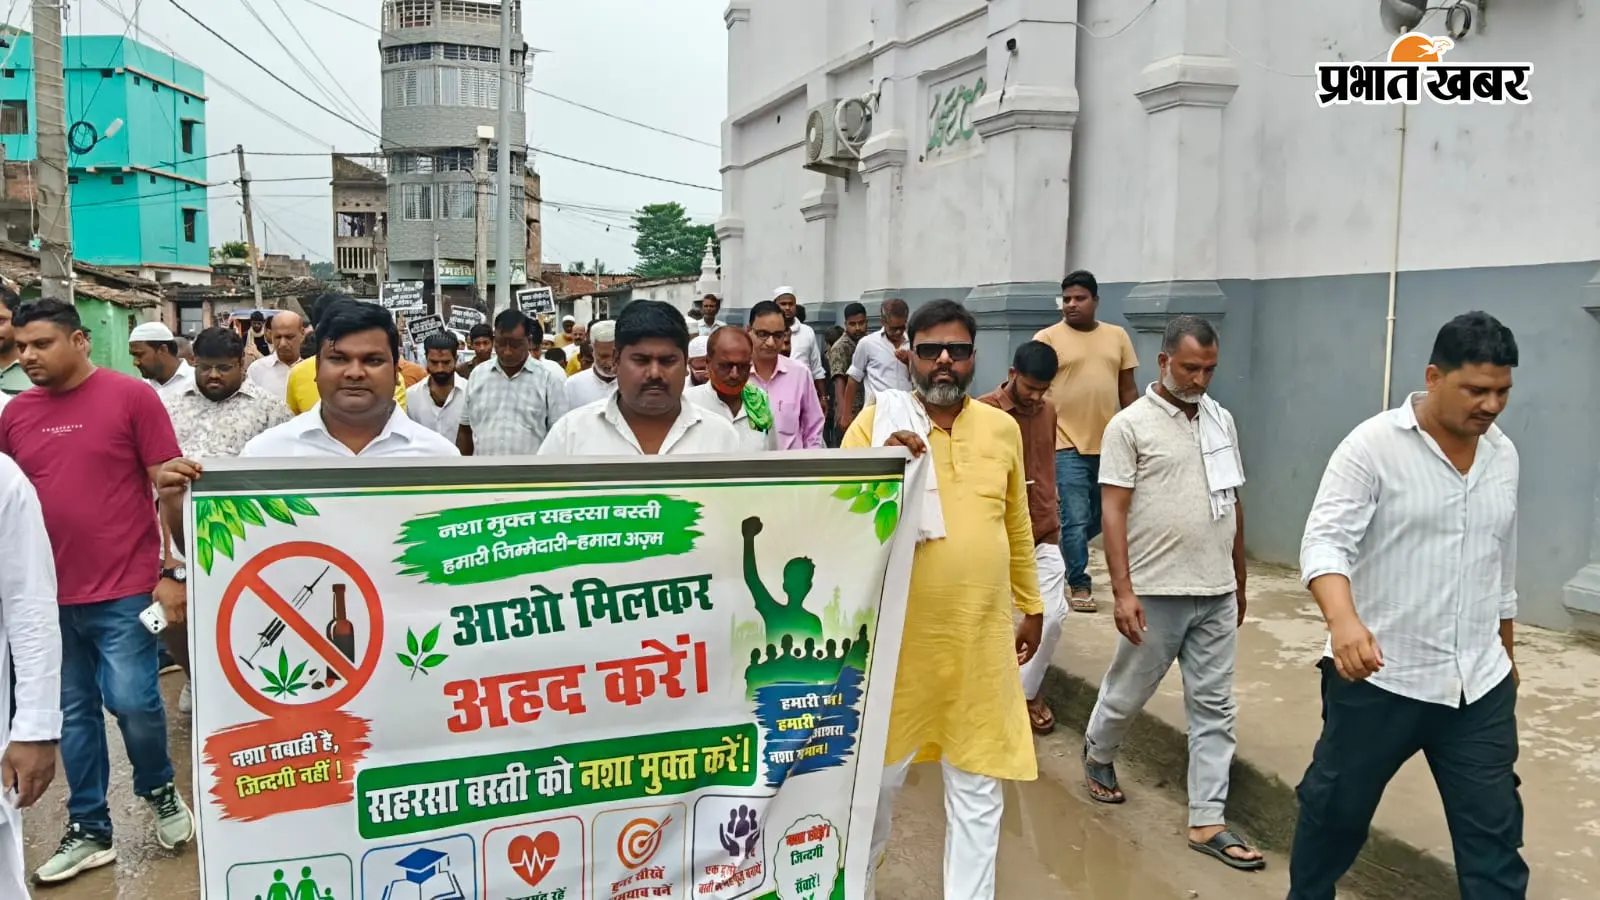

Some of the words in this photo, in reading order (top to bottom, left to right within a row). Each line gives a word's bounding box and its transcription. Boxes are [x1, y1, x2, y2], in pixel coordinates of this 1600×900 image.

[437, 518, 483, 538] नशा
[486, 511, 537, 537] मुक्त
[539, 505, 610, 524] सहरसा
[612, 499, 662, 519] बस्ती
[441, 545, 489, 575] हमारी
[450, 584, 566, 647] आओ
[570, 573, 714, 629] मिलकर
[443, 664, 587, 734] अहद
[780, 693, 820, 710] हमारी
[776, 713, 816, 732] हमारी
[229, 743, 267, 768] नशा
[268, 732, 319, 761] तबाही
[768, 750, 795, 764] नशा
[235, 765, 297, 798] जिन्दगी
[298, 759, 332, 784] नहीं
[365, 779, 460, 824] सहरसा
[463, 762, 531, 808] बस्ती
[535, 755, 575, 797] को
[578, 755, 635, 790] नशा
[638, 748, 698, 794] मुक्त
[701, 733, 750, 774] करें!
[790, 844, 825, 866] जिन्दगी
